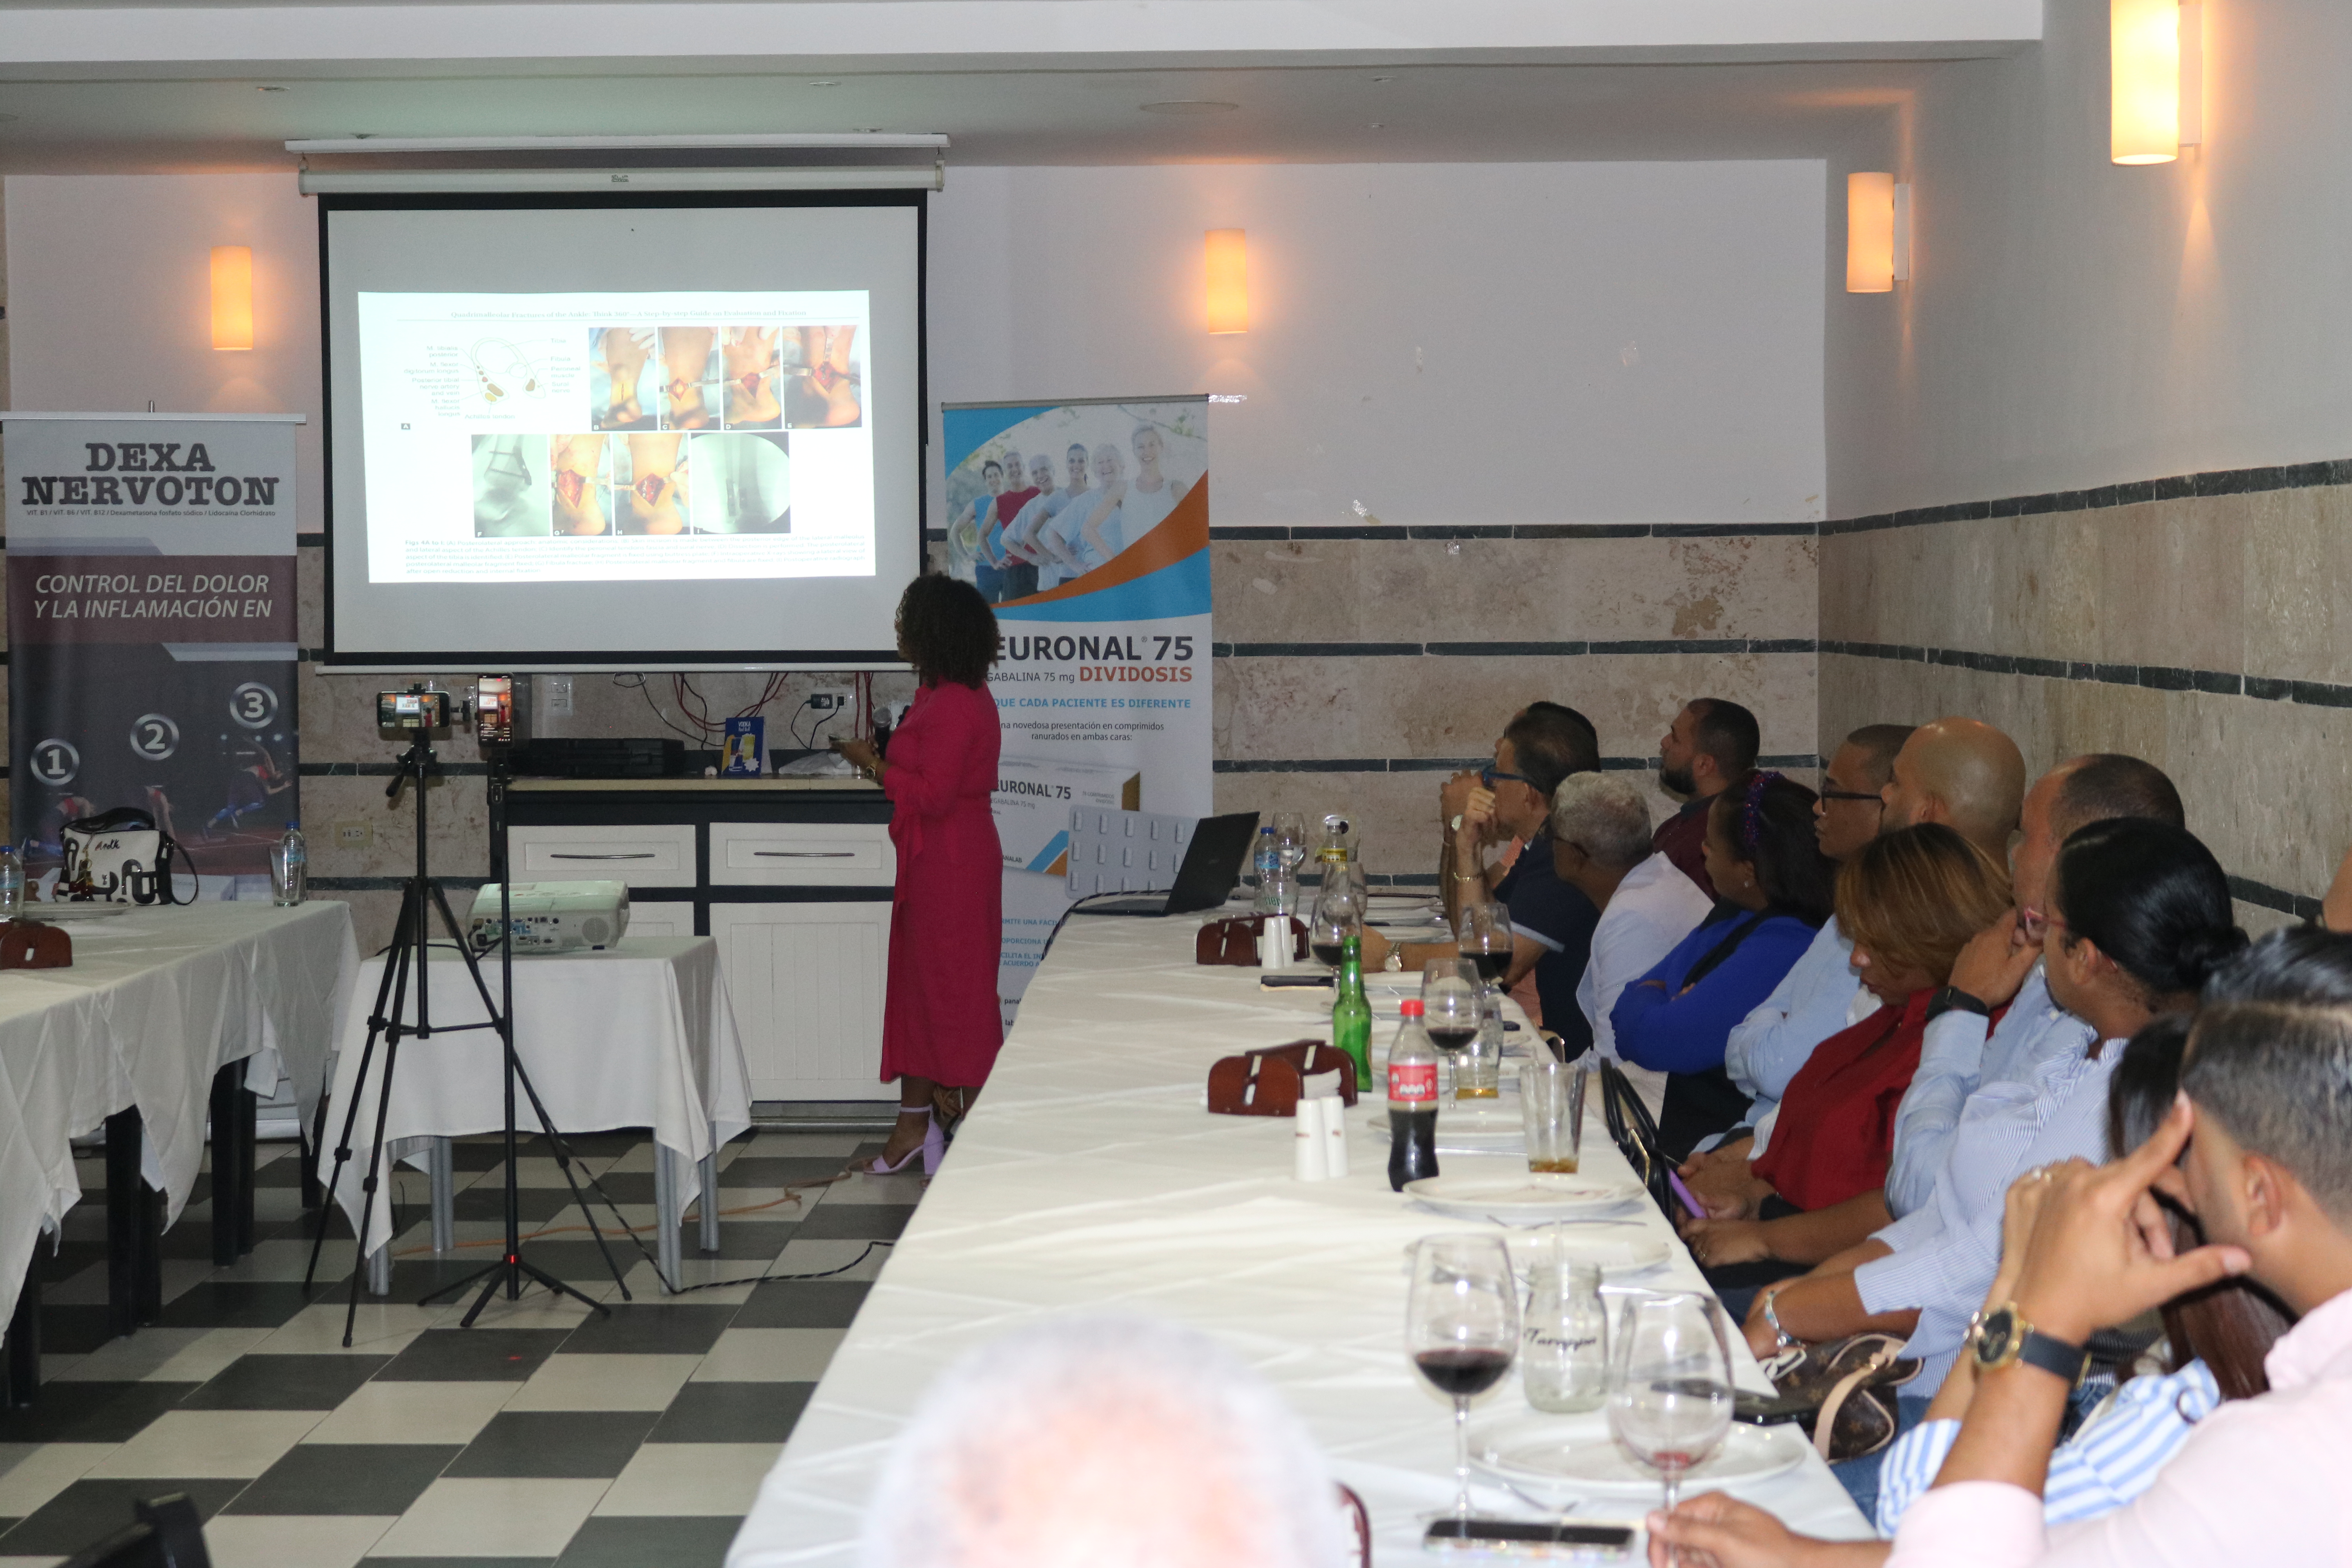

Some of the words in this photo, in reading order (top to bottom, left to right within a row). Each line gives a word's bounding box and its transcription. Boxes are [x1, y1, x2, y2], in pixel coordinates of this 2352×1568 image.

[85, 443, 215, 472] DEXA
[22, 477, 279, 505] NERVOTON
[36, 575, 140, 593] CONTROL
[146, 575, 186, 593] DEL
[192, 575, 269, 593] DOLOR
[34, 601, 49, 618] Y
[52, 601, 79, 618] LA
[85, 595, 238, 618] INFLAMACIÓN
[243, 600, 272, 617] EN
[1153, 636, 1193, 661] 75
[986, 672, 1040, 681] GABALINA
[1044, 673, 1055, 681] 75
[1059, 673, 1074, 683] mg
[1080, 666, 1192, 682] DIVIDOSIS
[244, 691, 264, 717] 3
[1020, 698, 1049, 707] CADA
[1053, 699, 1107, 707] PACIENTE
[1111, 699, 1125, 707] ES
[1129, 699, 1191, 708] DIFERENTE
[145, 723, 165, 750] 2
[1051, 721, 1100, 730] presentación
[1115, 722, 1164, 731] comprimidos
[1083, 732, 1108, 740] ambas
[47, 749, 66, 775] 1
[999, 779, 1051, 797] URONAL
[1056, 786, 1071, 800] 75
